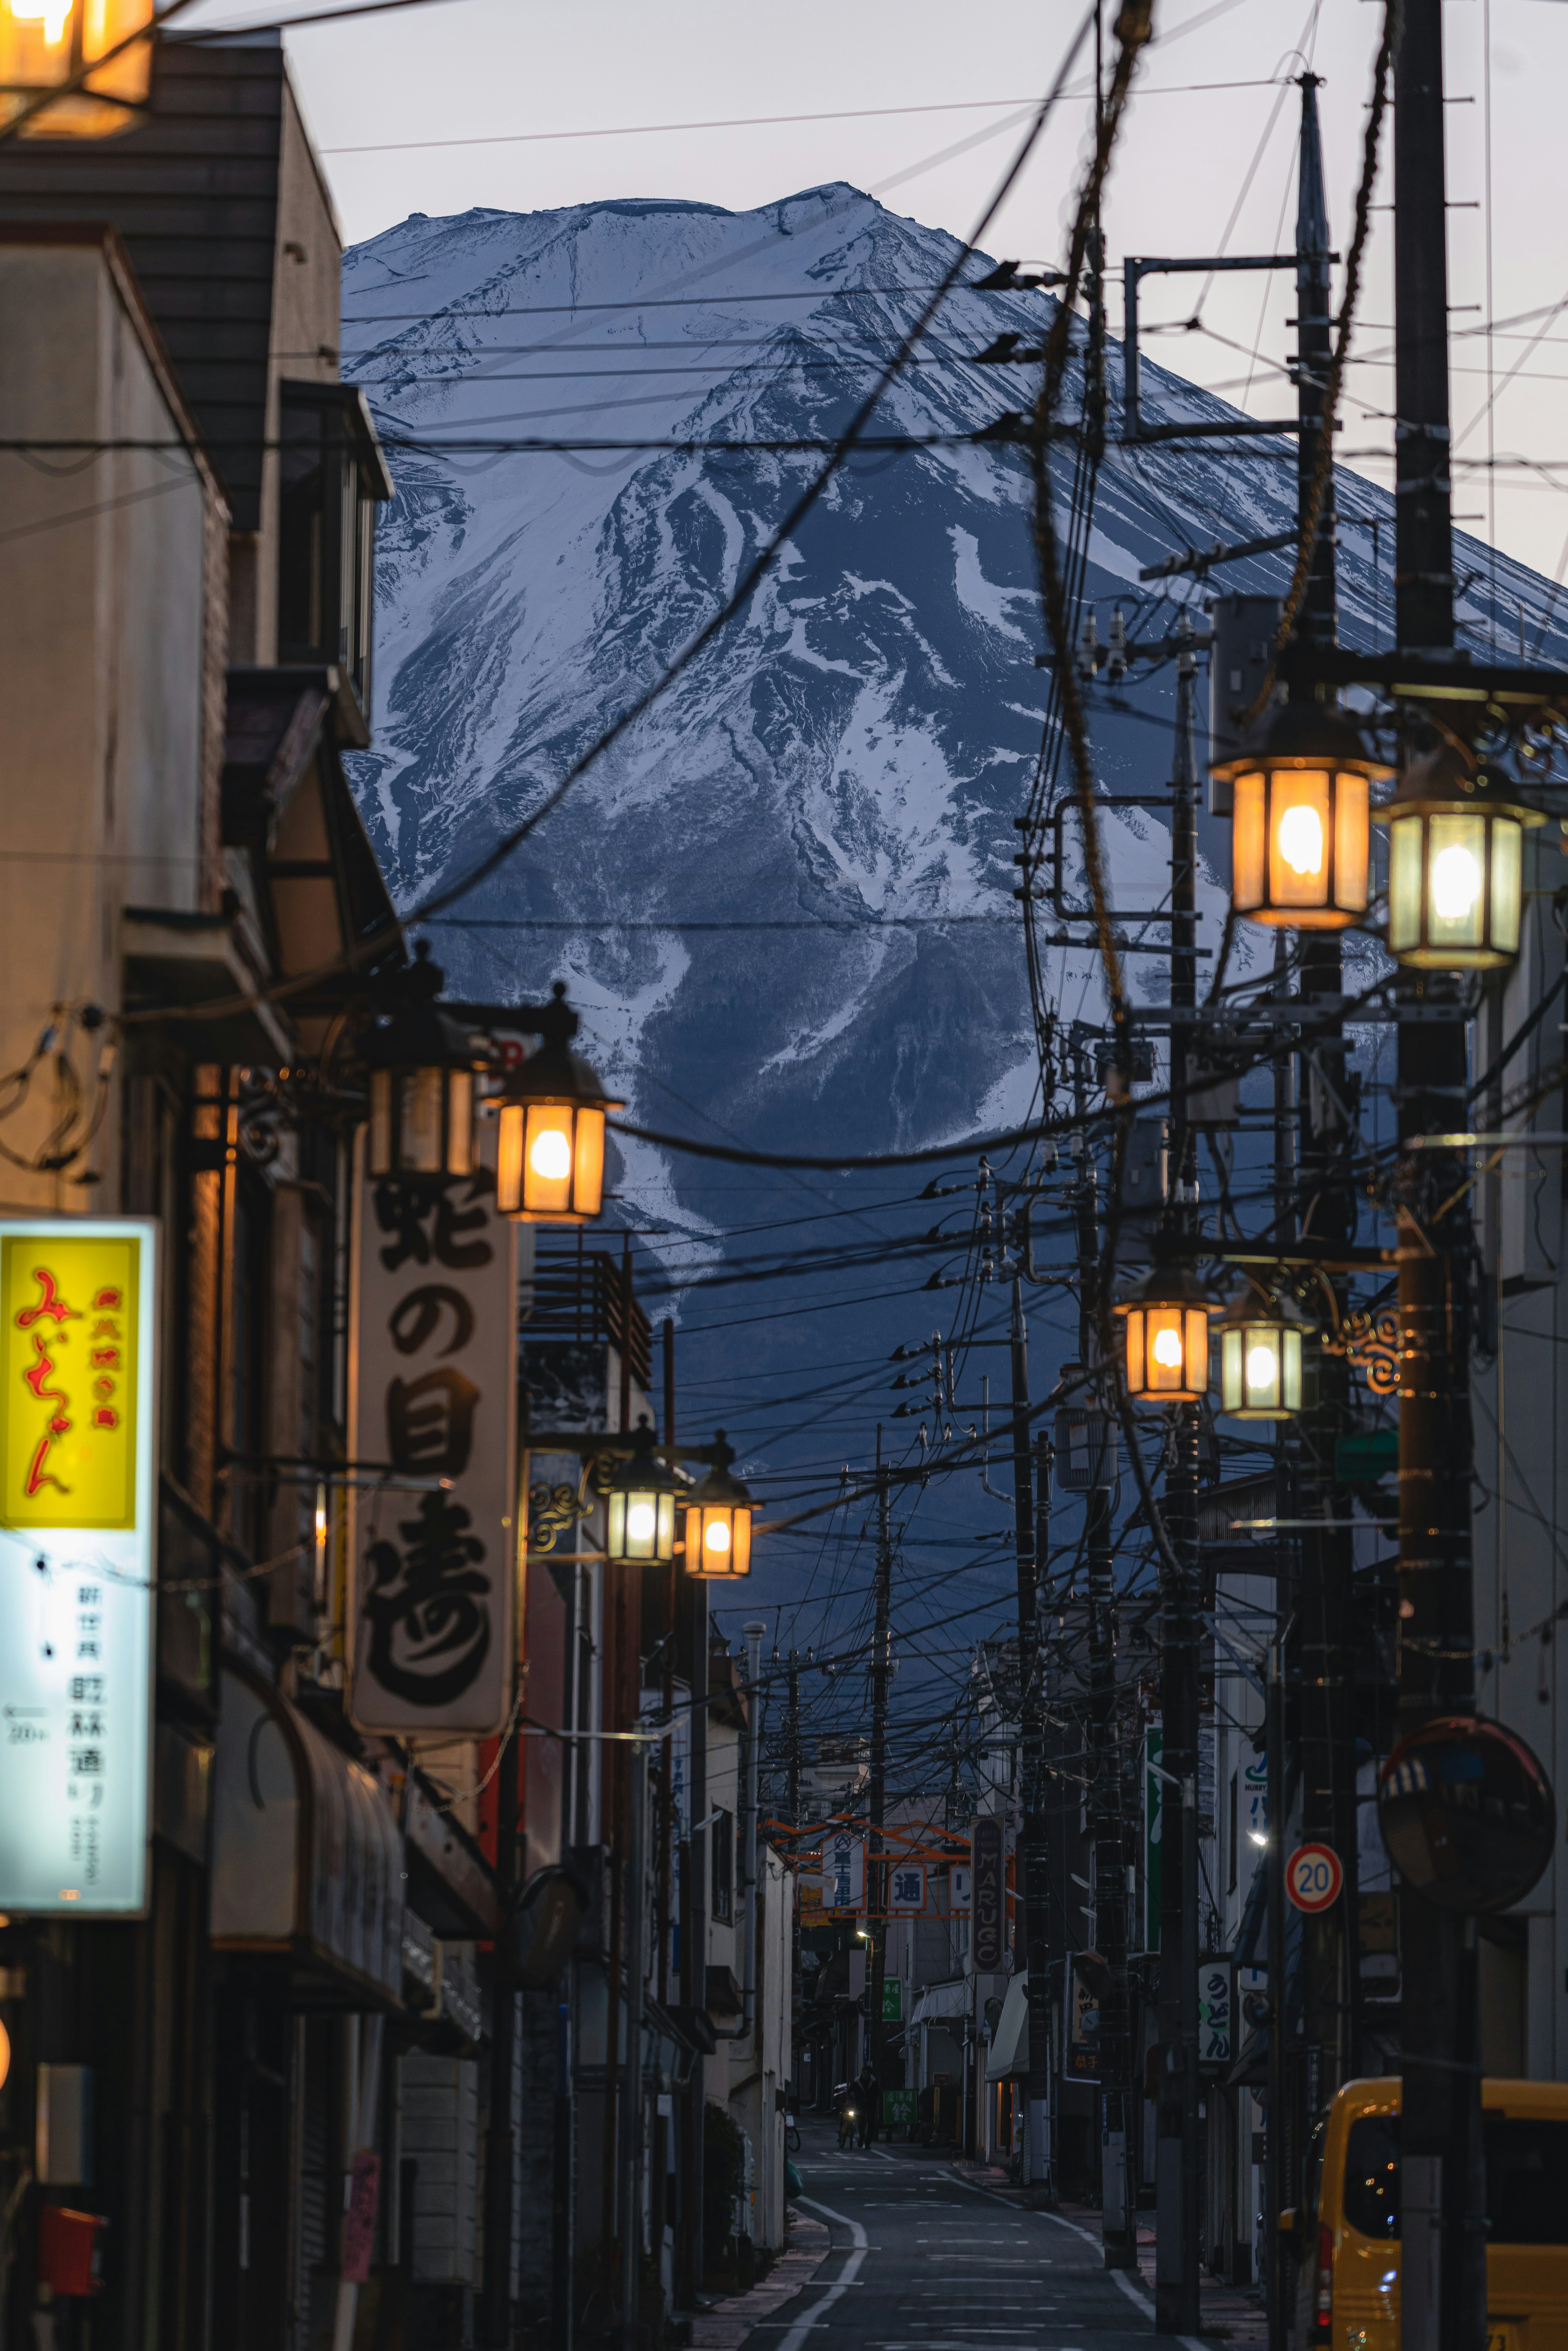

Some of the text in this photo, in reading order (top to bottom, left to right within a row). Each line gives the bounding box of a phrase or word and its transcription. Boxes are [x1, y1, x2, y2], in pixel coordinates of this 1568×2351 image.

[1298, 1863, 1329, 1892] 20
[1207, 1973, 1229, 2059] うどん
